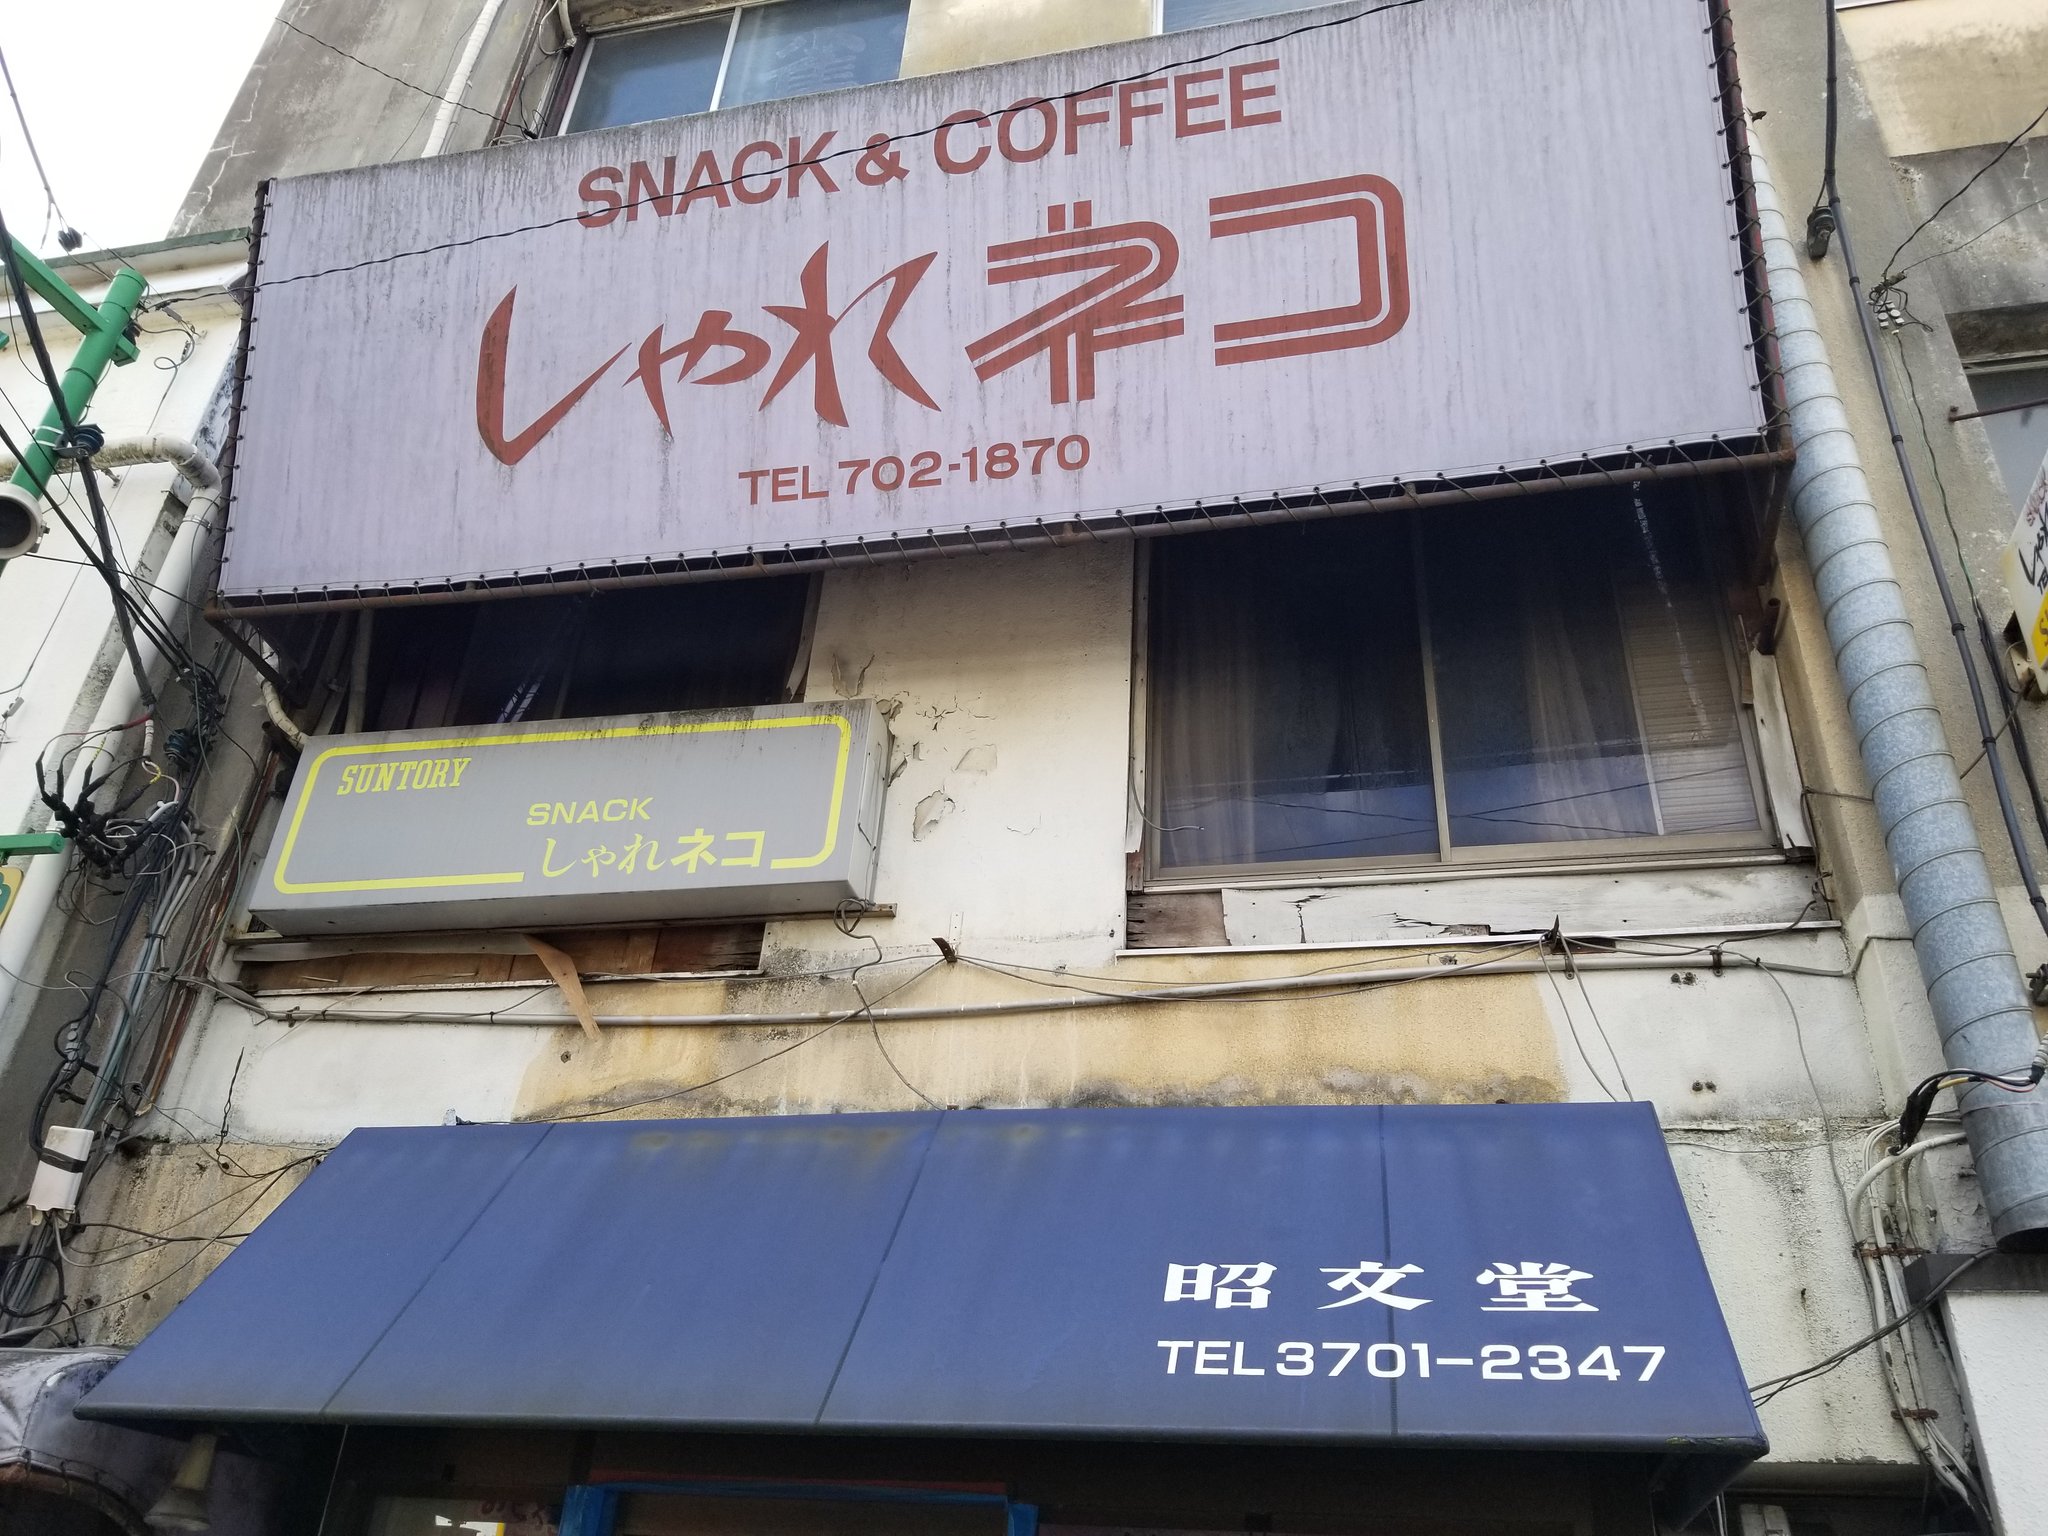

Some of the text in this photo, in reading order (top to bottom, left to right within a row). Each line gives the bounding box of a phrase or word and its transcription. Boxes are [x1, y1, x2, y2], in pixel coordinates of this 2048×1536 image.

[577, 57, 1282, 229] SNACK & COFFEE
[476, 173, 1411, 467] しゃれネコ
[740, 434, 1090, 504] TEL 702-1870
[336, 756, 472, 796] SUNTORY
[526, 797, 652, 827] SNACK
[540, 827, 768, 879] しゃれネコ
[1163, 1260, 1600, 1312] 昭文堂
